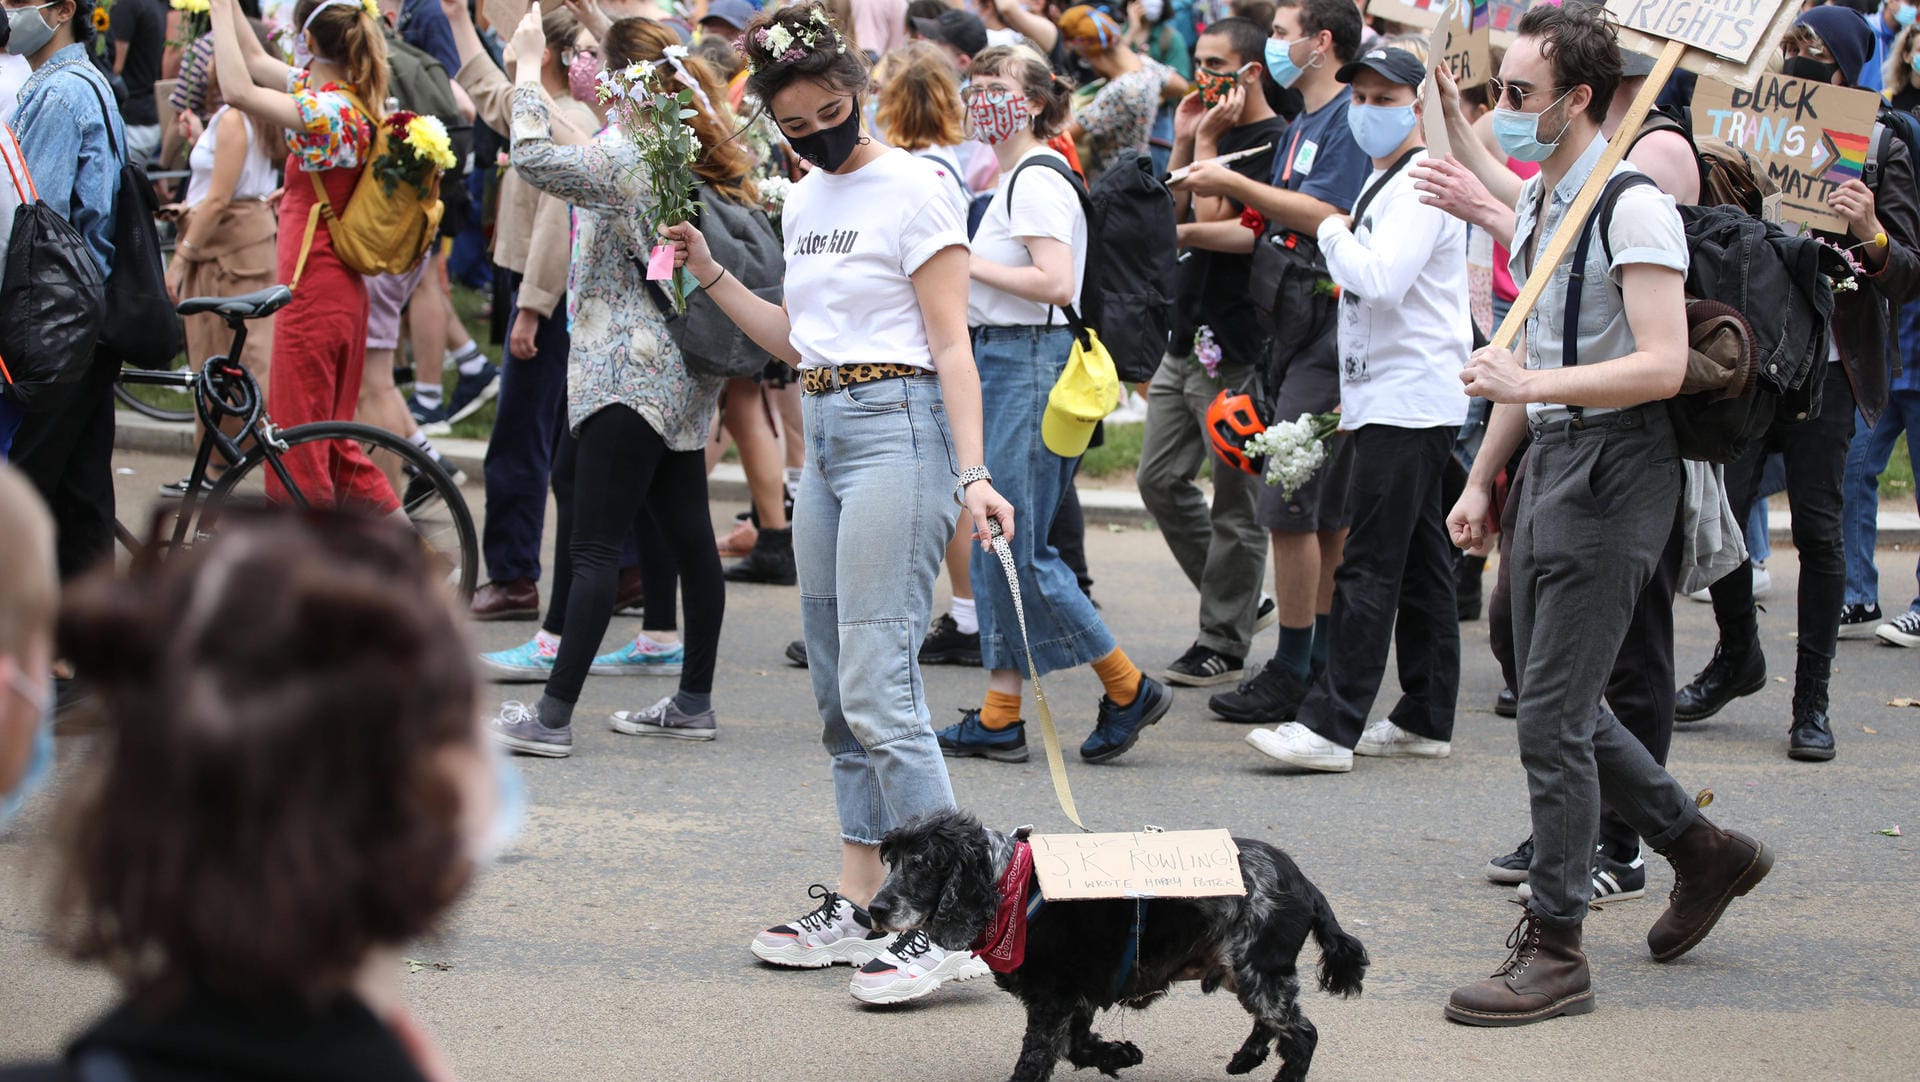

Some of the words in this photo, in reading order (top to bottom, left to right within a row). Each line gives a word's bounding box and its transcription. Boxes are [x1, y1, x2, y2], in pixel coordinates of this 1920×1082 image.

[1625, 0, 1755, 50] RIGHTS
[1731, 76, 1820, 122] BLACK
[1706, 109, 1805, 157] TRANS
[826, 229, 859, 254] kill
